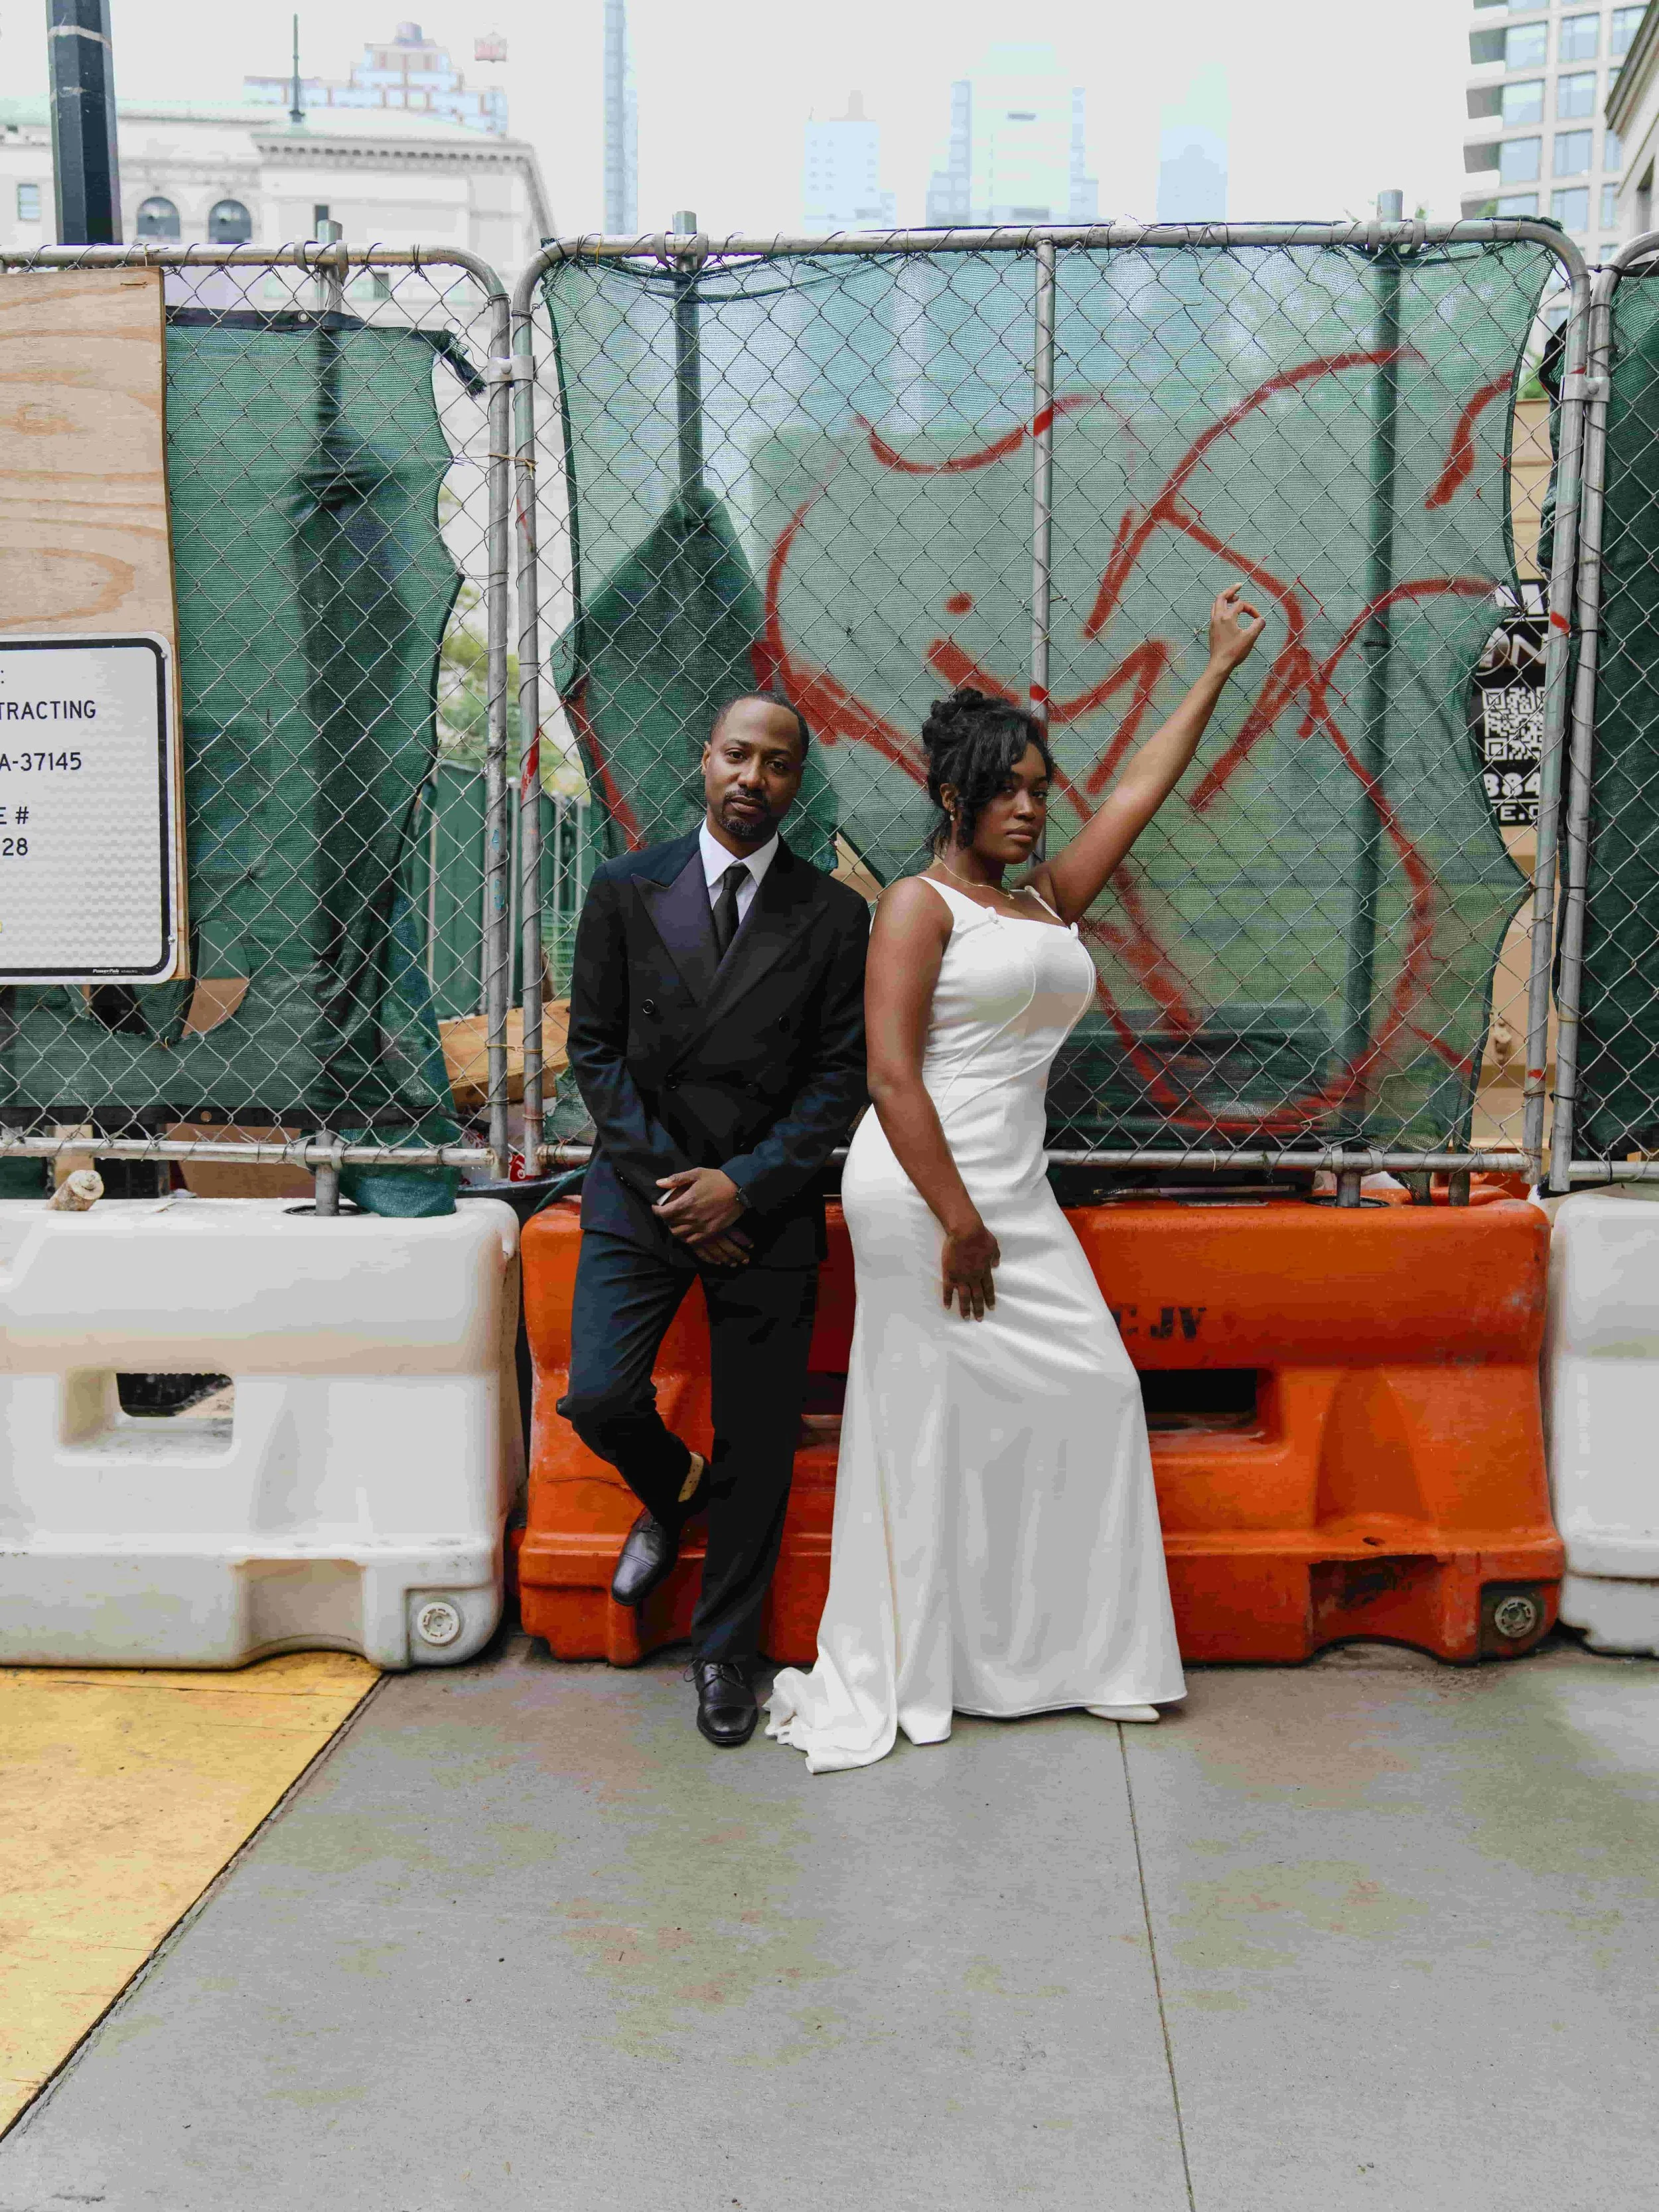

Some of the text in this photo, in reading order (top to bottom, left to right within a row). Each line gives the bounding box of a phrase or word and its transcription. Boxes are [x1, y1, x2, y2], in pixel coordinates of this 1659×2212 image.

[0, 751, 82, 771] A-37145
[15, 806, 29, 824] #
[2, 838, 29, 856] 28
